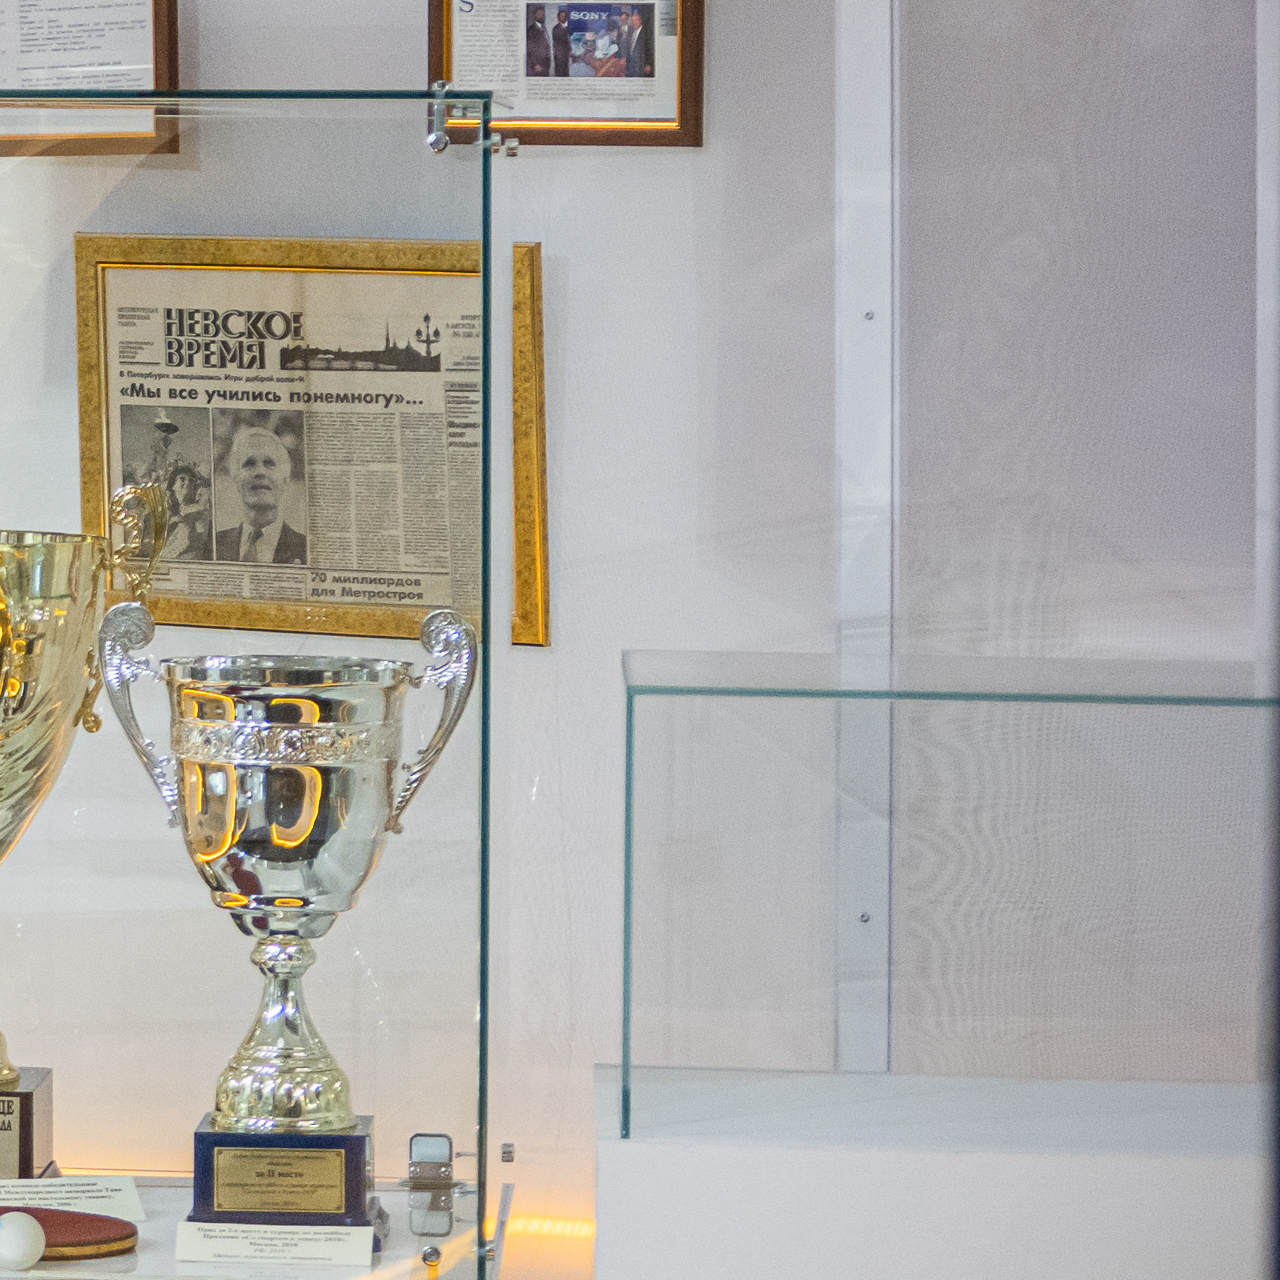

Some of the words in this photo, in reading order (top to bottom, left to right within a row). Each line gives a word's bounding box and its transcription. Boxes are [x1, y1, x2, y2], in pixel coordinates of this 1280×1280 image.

[570, 11, 609, 20] SONY
[163, 307, 305, 341] НЕВСКОЕ
[165, 337, 266, 370] ВРЕМЯ
[127, 371, 170, 381] Петербурге
[172, 373, 222, 381] завершились
[224, 373, 244, 382] Игры
[245, 374, 275, 383] доброй
[120, 383, 161, 399] «Мы
[168, 387, 200, 400] все
[205, 388, 282, 404] учились
[311, 572, 328, 584] 70
[331, 573, 422, 588] миллиардов
[311, 586, 336, 599] для
[340, 586, 424, 602] Метростроя
